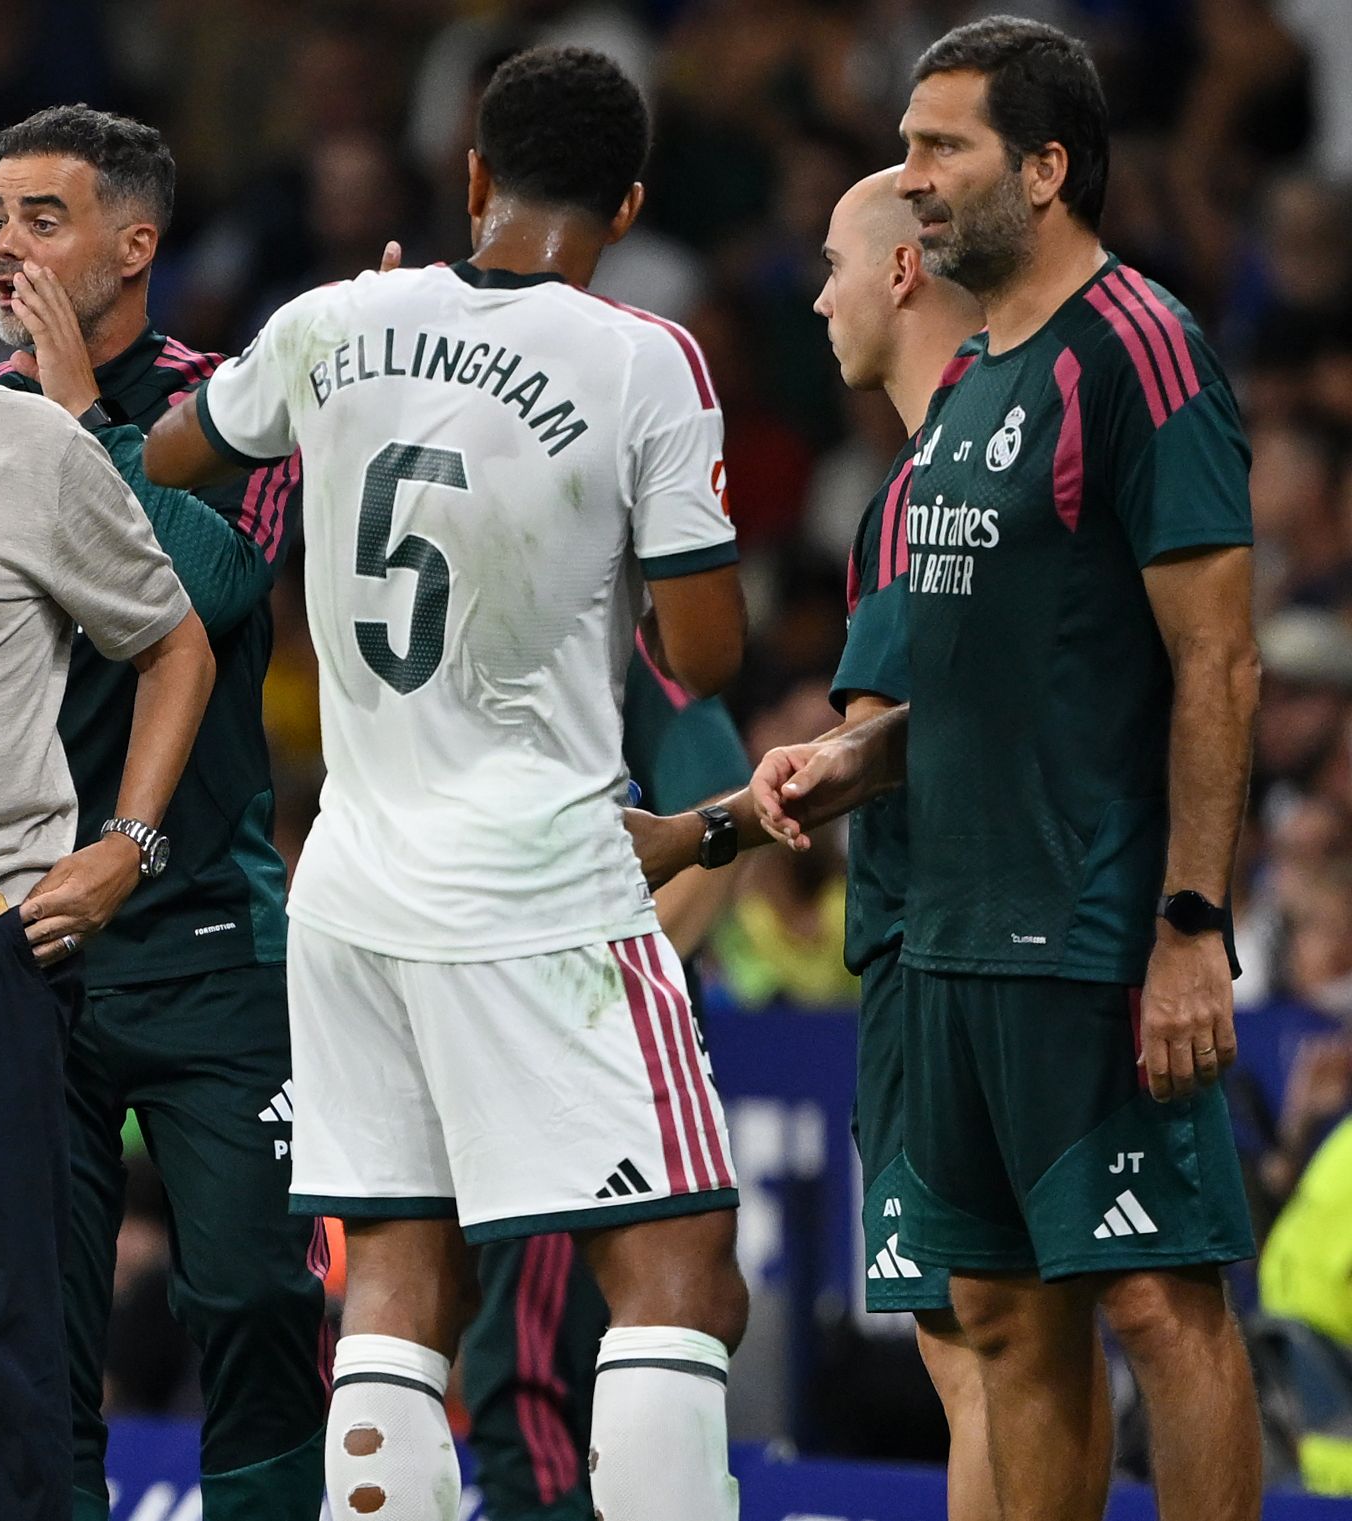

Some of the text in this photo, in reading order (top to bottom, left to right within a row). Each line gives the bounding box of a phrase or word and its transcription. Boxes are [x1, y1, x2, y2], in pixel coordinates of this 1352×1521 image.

[308, 328, 589, 458] BELLINGHAM
[953, 440, 973, 462] JT
[906, 494, 1000, 549] mirates
[355, 441, 470, 696] 5
[921, 553, 975, 596] BETTER
[1108, 1151, 1145, 1174] JT
